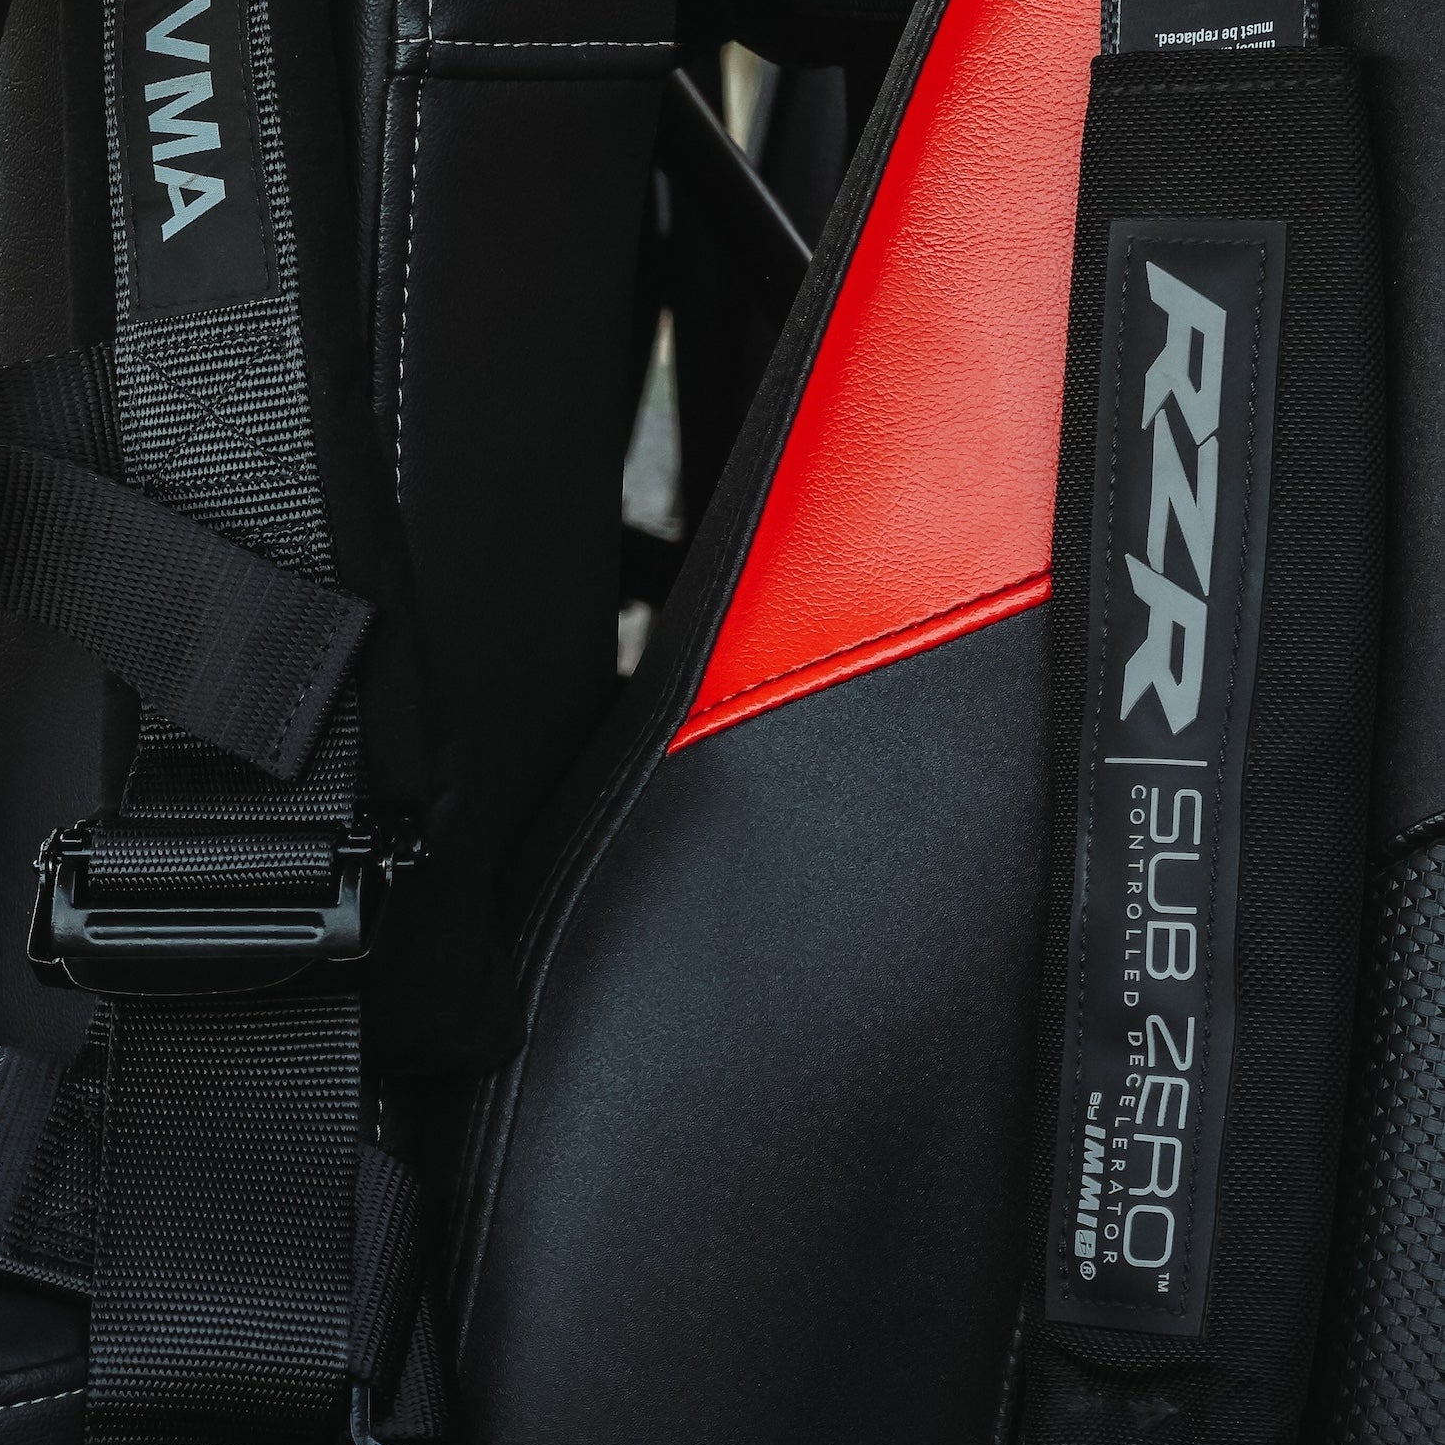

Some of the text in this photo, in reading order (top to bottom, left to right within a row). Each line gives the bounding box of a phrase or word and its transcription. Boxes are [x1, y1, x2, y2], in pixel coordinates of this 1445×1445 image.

[1153, 27, 1219, 48] replaced.
[1221, 27, 1239, 41] be
[1241, 20, 1275, 39] must
[1119, 259, 1228, 736] RZR
[1145, 786, 1203, 983] SUB
[1102, 783, 1147, 1264] CONTROLLED DECELERATOR
[1076, 1123, 1107, 1229] IMMI
